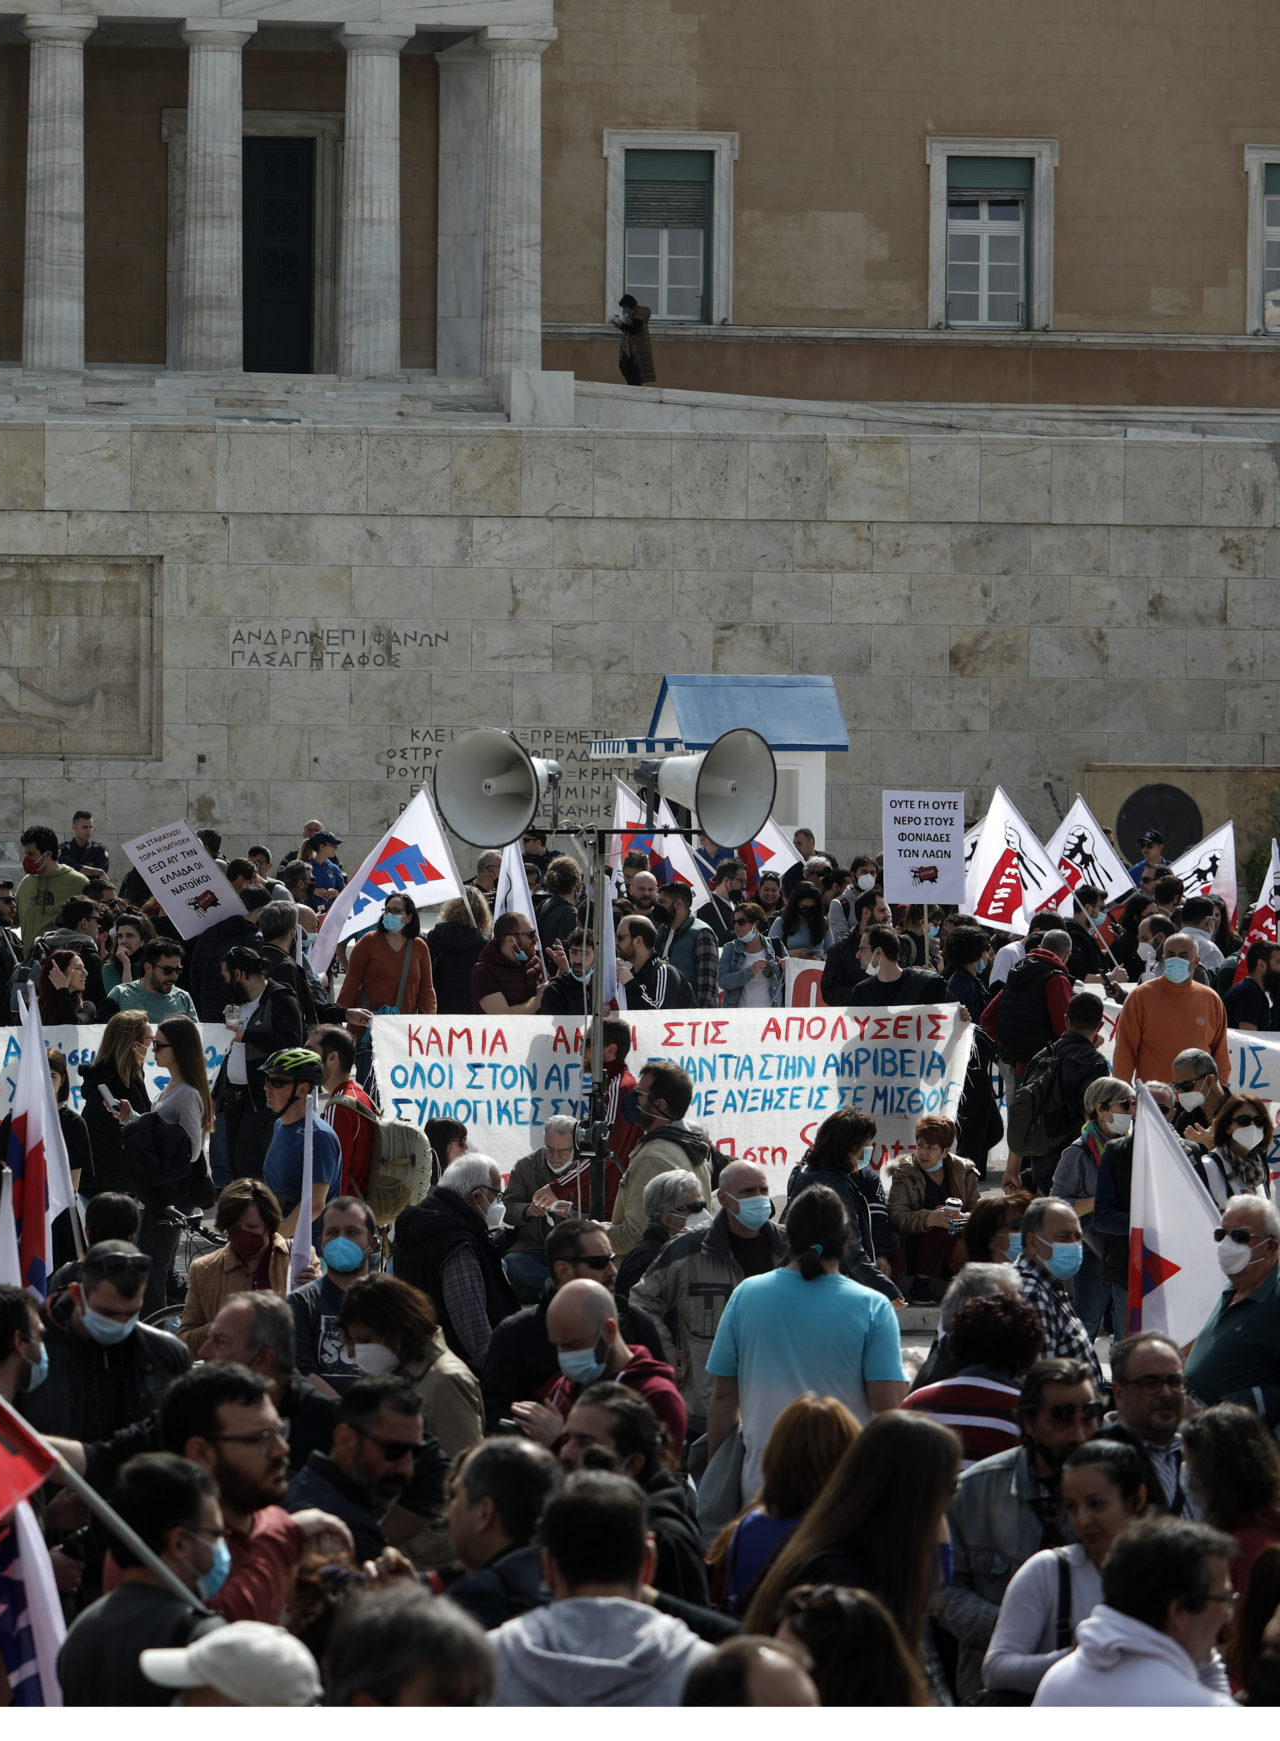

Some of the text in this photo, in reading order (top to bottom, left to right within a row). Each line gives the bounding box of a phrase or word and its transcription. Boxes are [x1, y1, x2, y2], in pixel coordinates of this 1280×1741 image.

[889, 800, 958, 810] ΟΥΤΕ ΓΗ ΟΥΤΕ
[893, 816, 955, 826] ΝΕΡΟ ΣΤΟΥΣ
[898, 832, 951, 842] ΦΟΝΙΑΔΕΣ
[148, 860, 167, 874] ΕΞΩ
[180, 848, 198, 860] ΤΗΝ
[897, 849, 951, 859] ΤΩΝ ΛΑΩΝ
[160, 861, 204, 885] ΕΛΛΑΔΑ ΟΙ
[408, 1024, 508, 1057] ΚΑΜΙΑ
[661, 1021, 730, 1047] ΣΤΙΣ
[761, 1014, 948, 1042] ΑΠΟΛΥΣΕΙΣ
[390, 1062, 453, 1089] ΟΛΟΙ
[466, 1062, 538, 1093] ΣΤΟΝ
[759, 1054, 816, 1080] ΣΤΗΝ
[822, 1047, 947, 1079] ΑΚΡΙΒΕΙΑ
[722, 1085, 830, 1114] ΑΥΞΗΣΕΙΣ
[836, 1085, 866, 1110] ΣΕ
